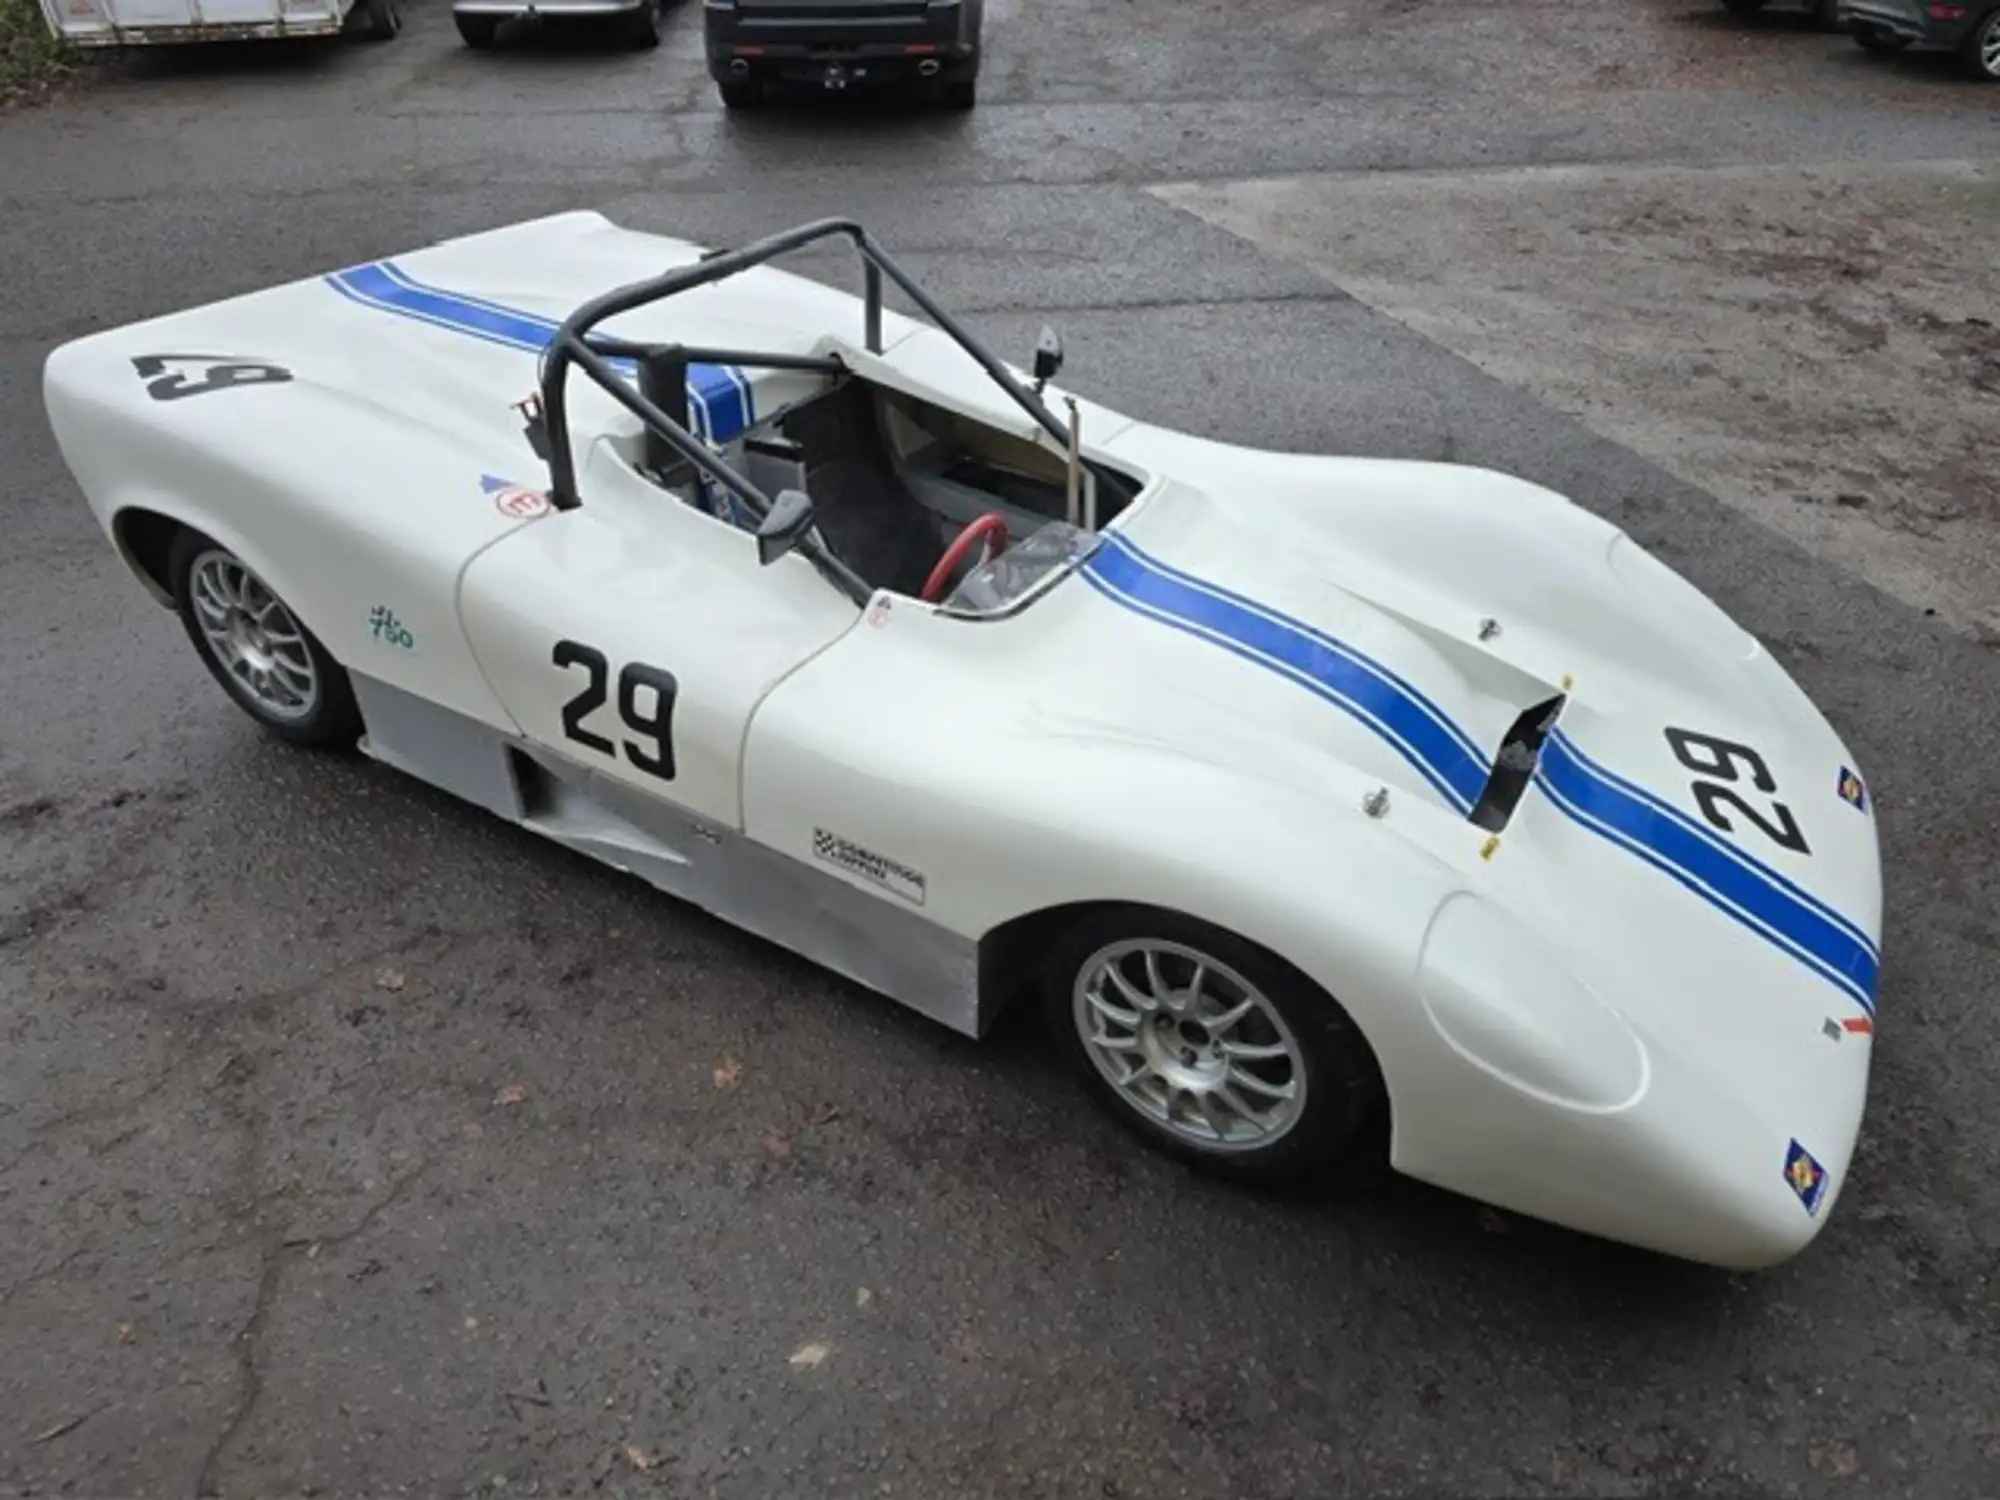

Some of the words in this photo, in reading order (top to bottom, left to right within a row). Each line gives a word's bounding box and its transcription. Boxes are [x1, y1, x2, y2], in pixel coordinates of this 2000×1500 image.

[369, 617, 414, 650] 750
[552, 639, 678, 782] 29
[1664, 726, 1812, 855] 29
